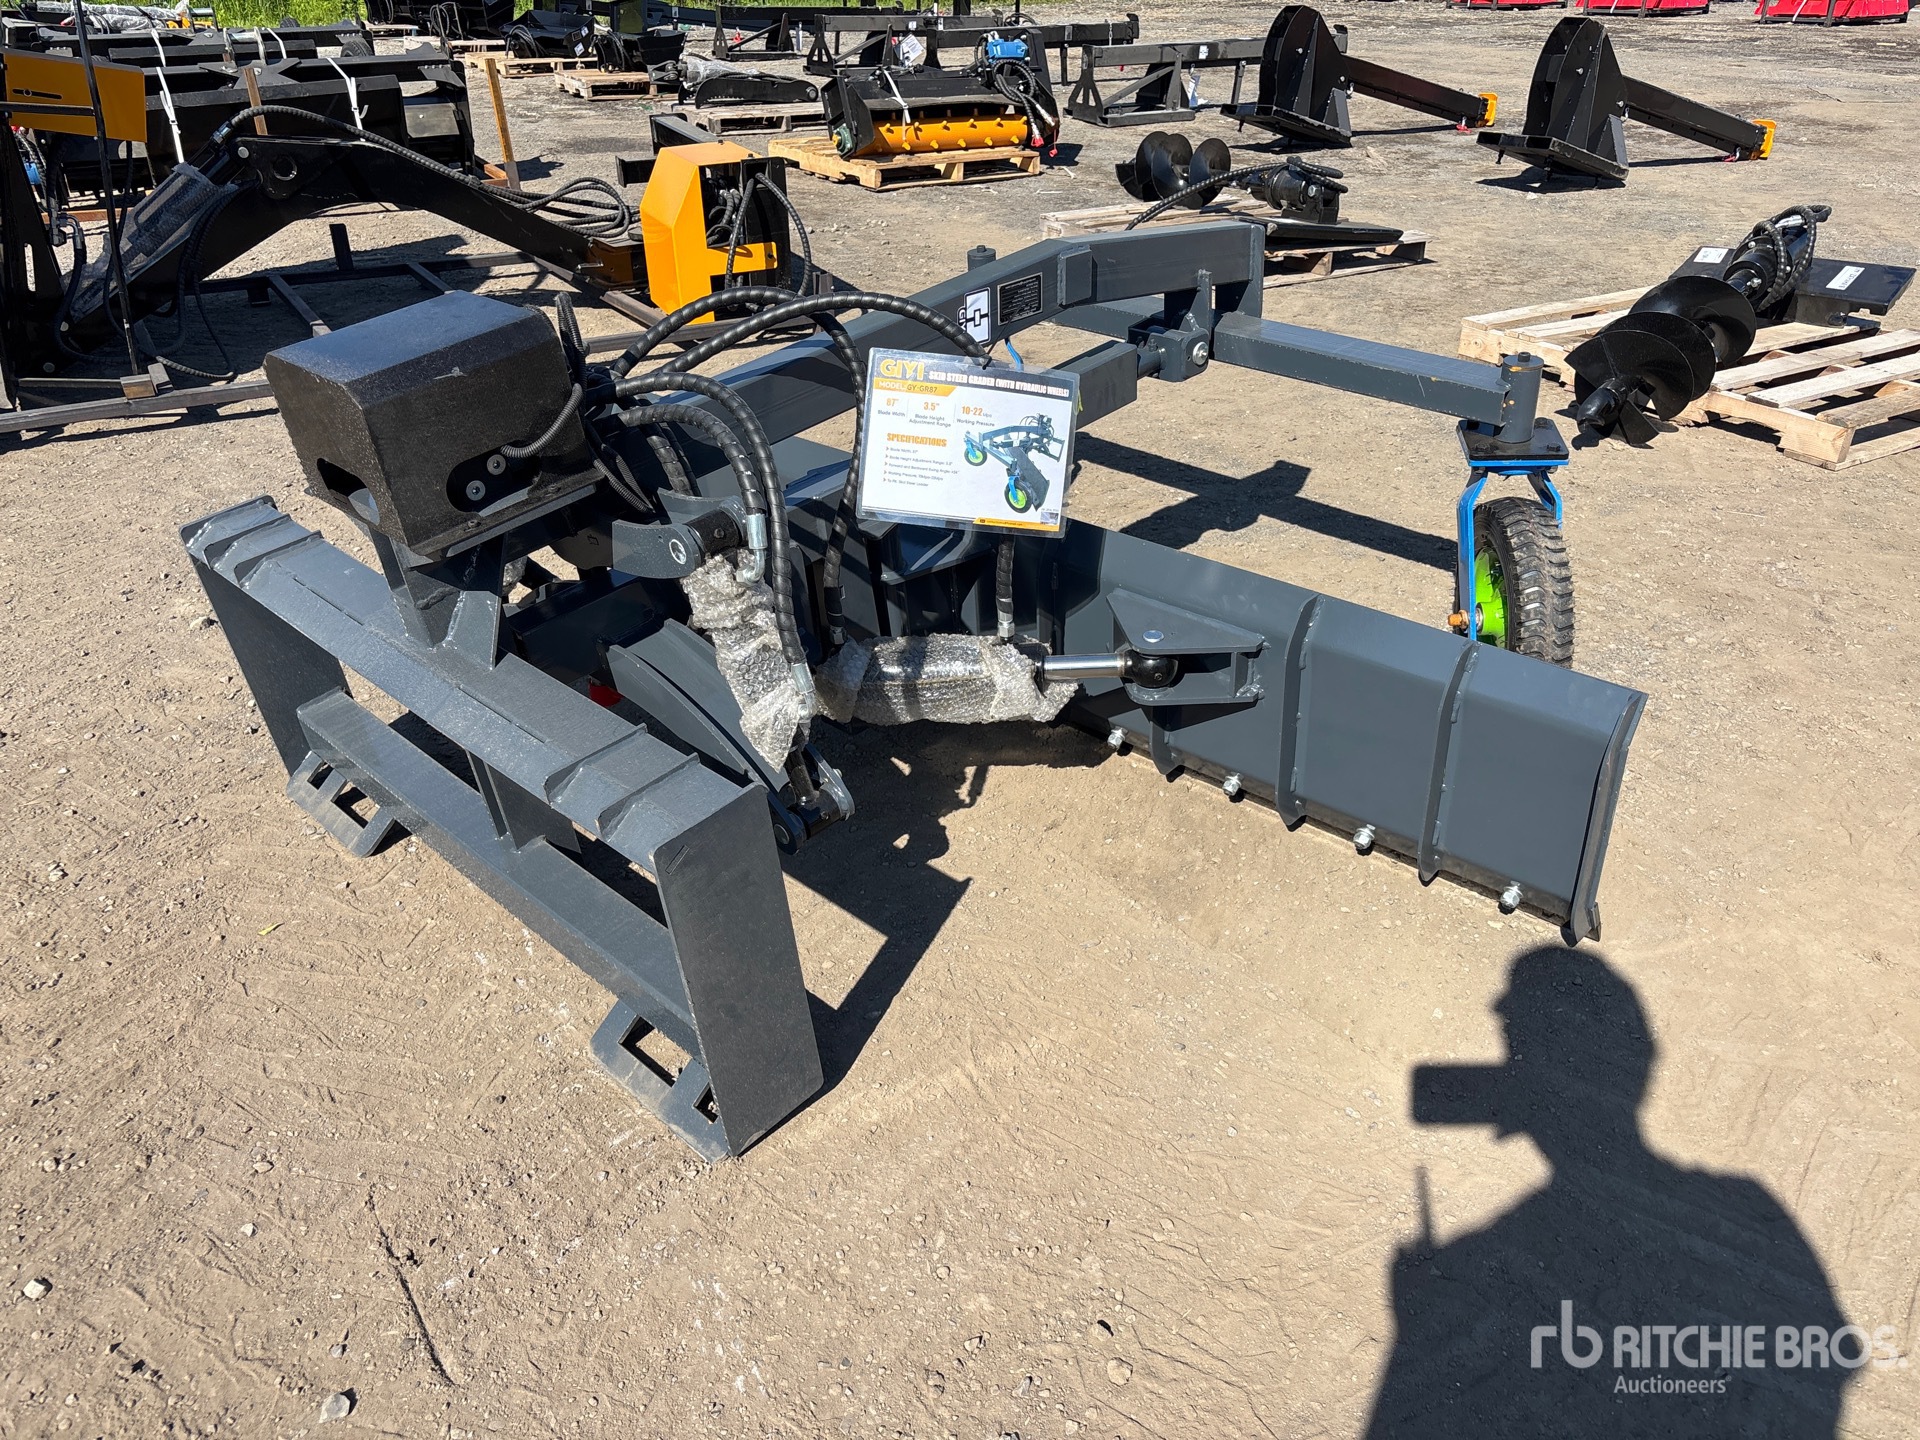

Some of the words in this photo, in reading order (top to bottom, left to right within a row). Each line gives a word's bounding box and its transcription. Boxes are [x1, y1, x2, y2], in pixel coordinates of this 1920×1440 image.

[880, 358, 925, 380] GIYI
[929, 370, 946, 380] SKID
[946, 372, 968, 384] STEER
[968, 375, 995, 387] GRADER
[995, 378, 1015, 389] (WITH
[1015, 381, 1046, 394] HYDRAULIC
[906, 384, 938, 393] GY-GR87
[961, 405, 983, 416] 10-22
[908, 418, 936, 426] Adjustment
[929, 414, 945, 422] Height
[956, 418, 975, 426] Working
[886, 432, 948, 447] SPECIFICATIONS
